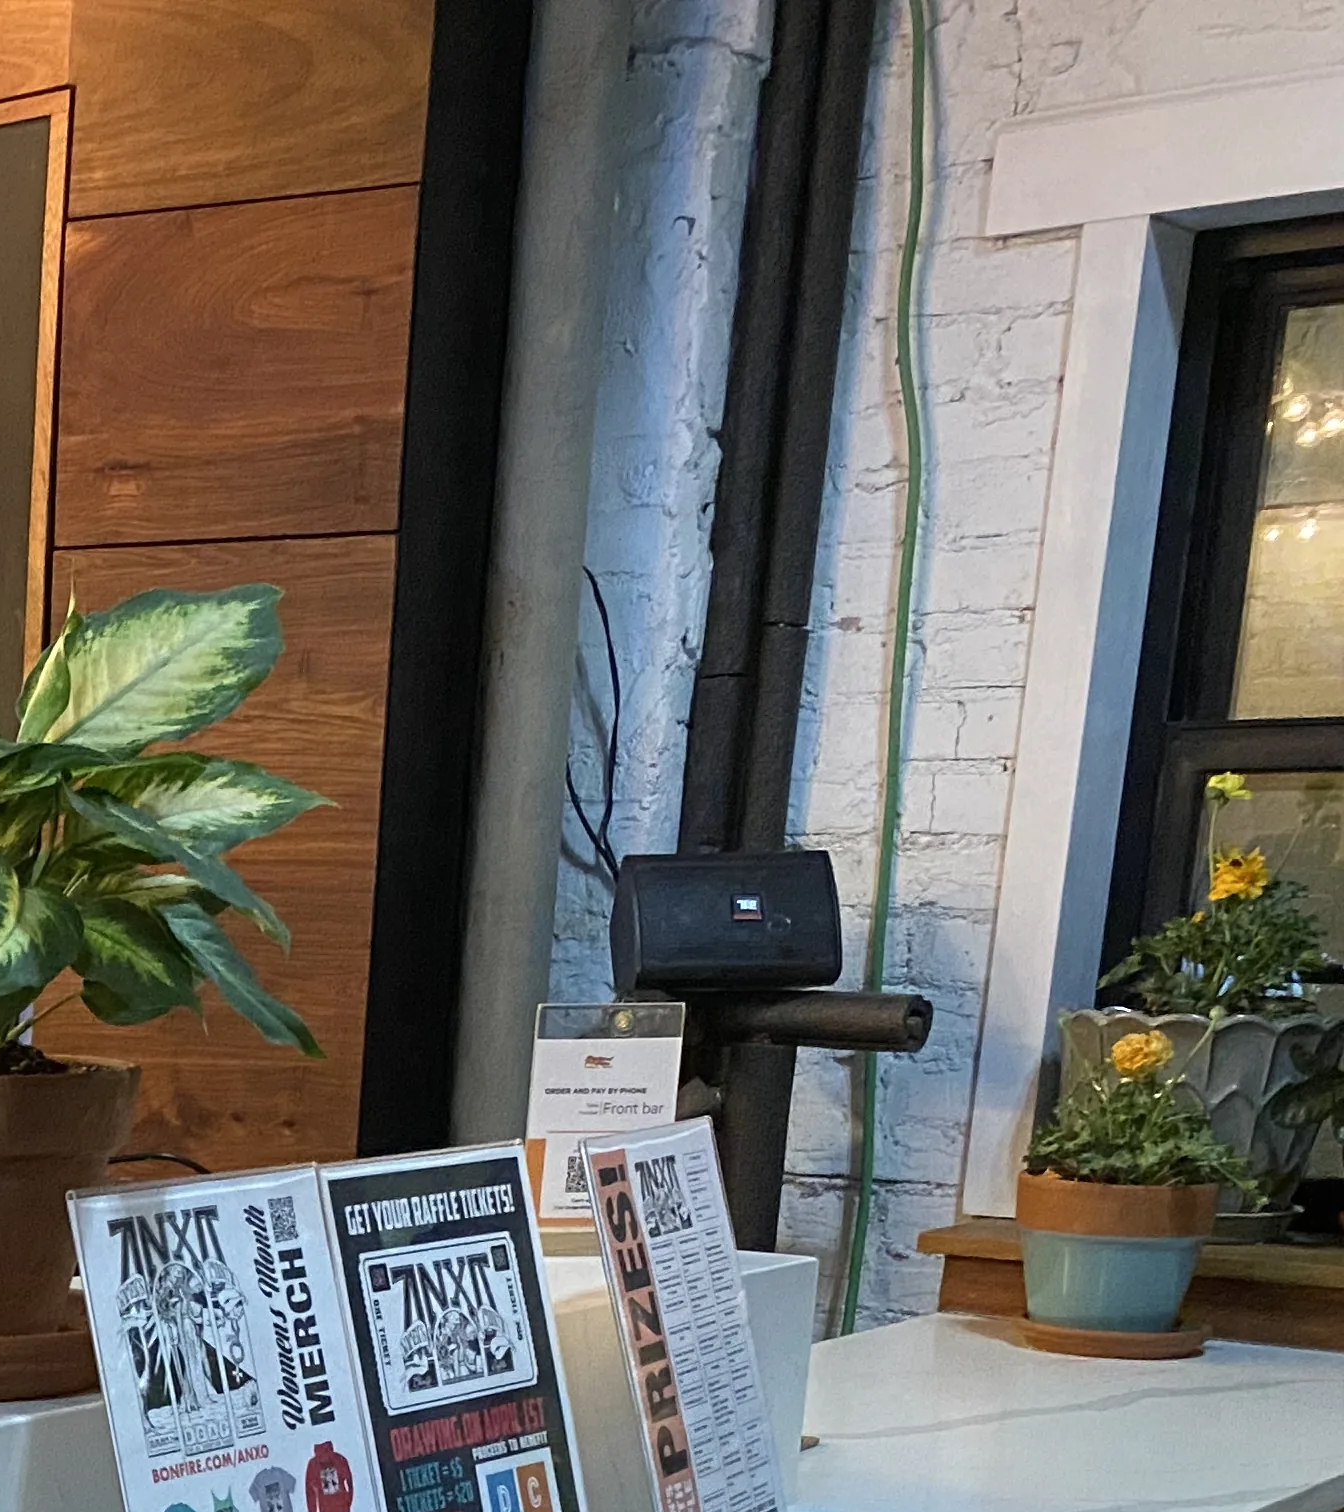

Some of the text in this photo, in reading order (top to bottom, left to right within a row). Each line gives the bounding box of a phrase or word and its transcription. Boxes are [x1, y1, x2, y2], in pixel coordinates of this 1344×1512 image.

[544, 1087, 647, 1095] ORDER AND PAY BY PHONE
[603, 1103, 638, 1116] Front
[642, 1102, 664, 1115] bar
[344, 1202, 372, 1236] GET
[370, 1196, 413, 1231] YOUR
[411, 1190, 461, 1227] RAFFLE
[458, 1183, 516, 1219] TICKETS!
[243, 1204, 305, 1431] Womens Month
[277, 1247, 335, 1426] MERCH
[598, 1163, 690, 1479] PRIZES!
[390, 1417, 462, 1461] DRAWING
[151, 1444, 269, 1484] BONFIRE.COM/ANXO
[407, 1461, 442, 1491] TICKET
[526, 1476, 542, 1509] C
